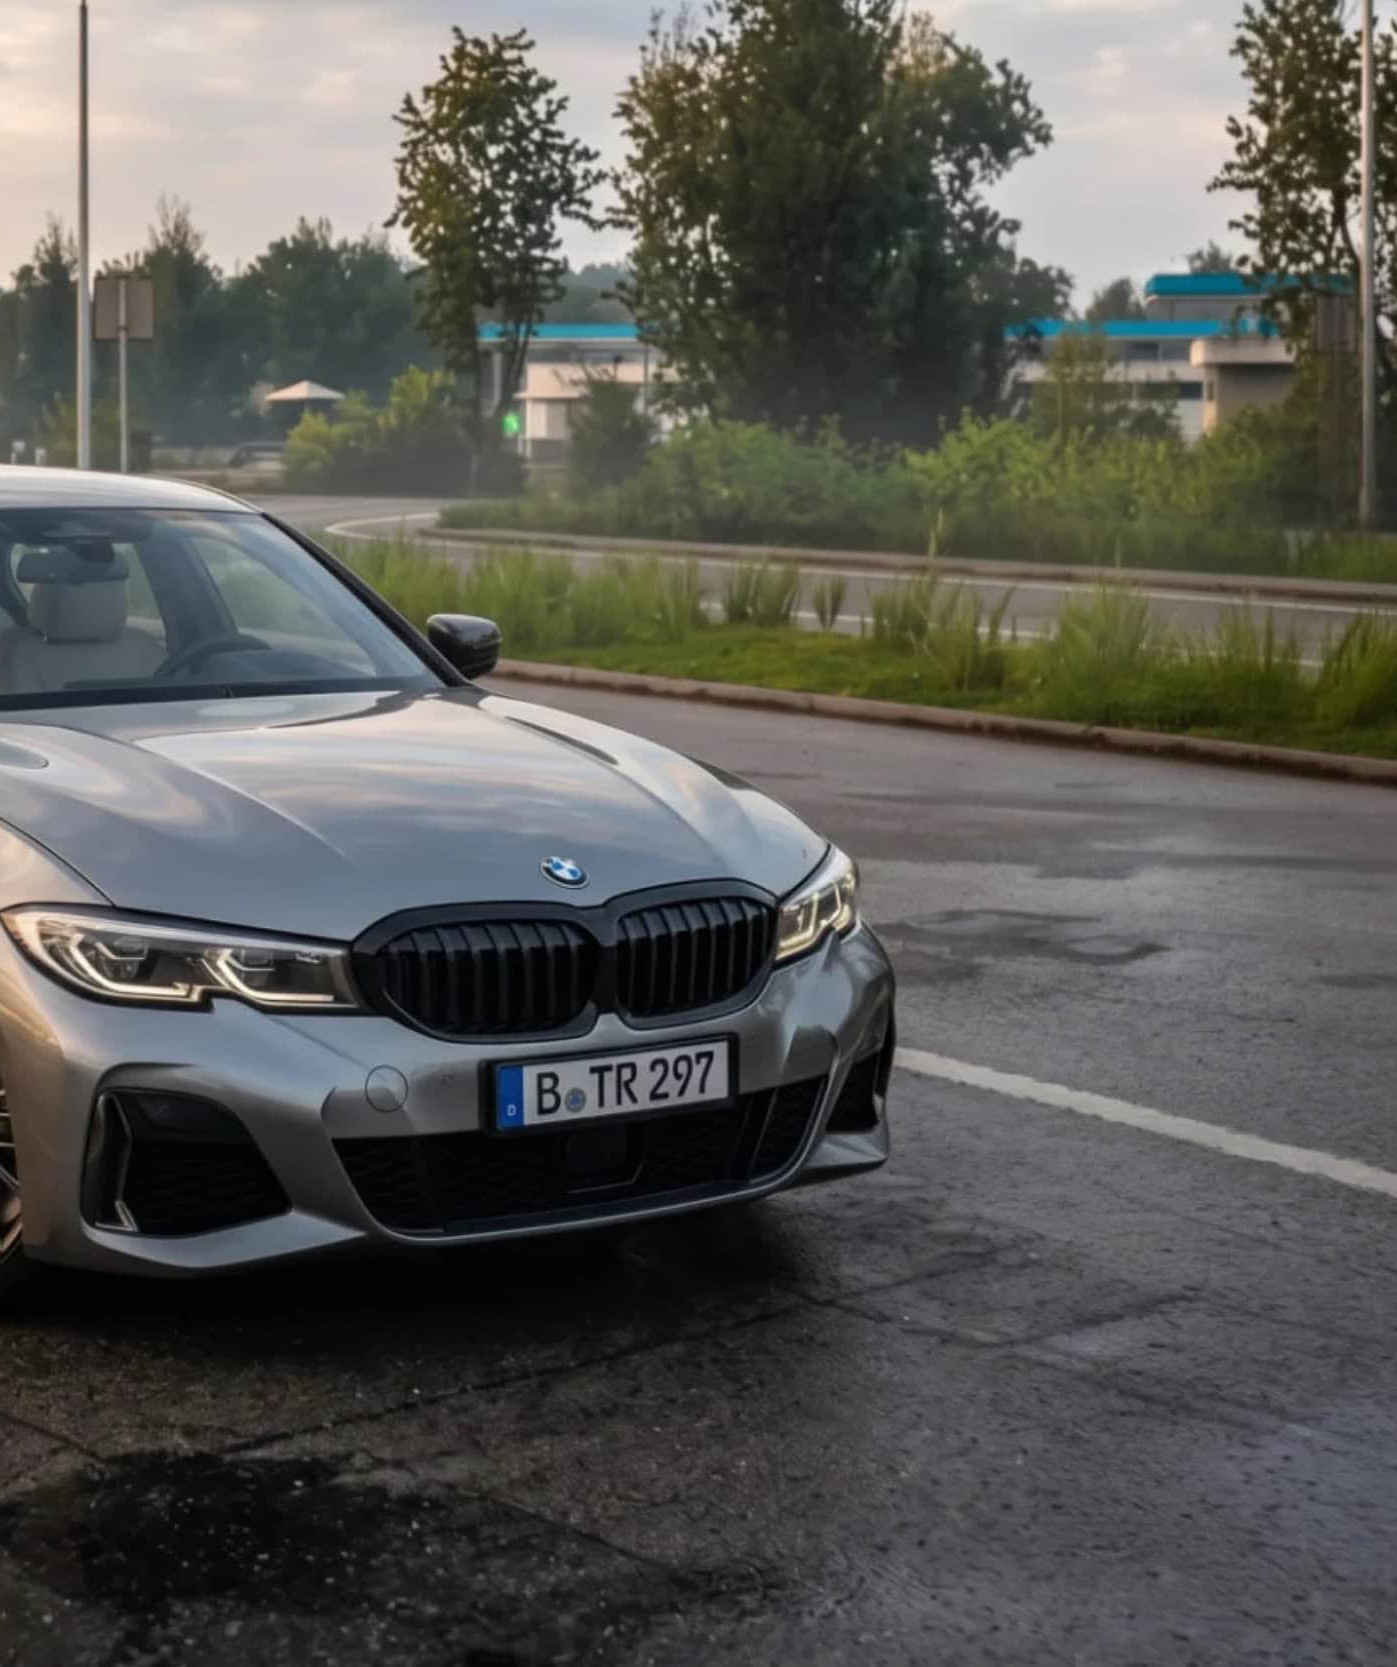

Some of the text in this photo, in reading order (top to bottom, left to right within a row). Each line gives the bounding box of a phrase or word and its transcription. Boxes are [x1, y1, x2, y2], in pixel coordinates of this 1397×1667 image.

[536, 1051, 714, 1116] B TR 297
